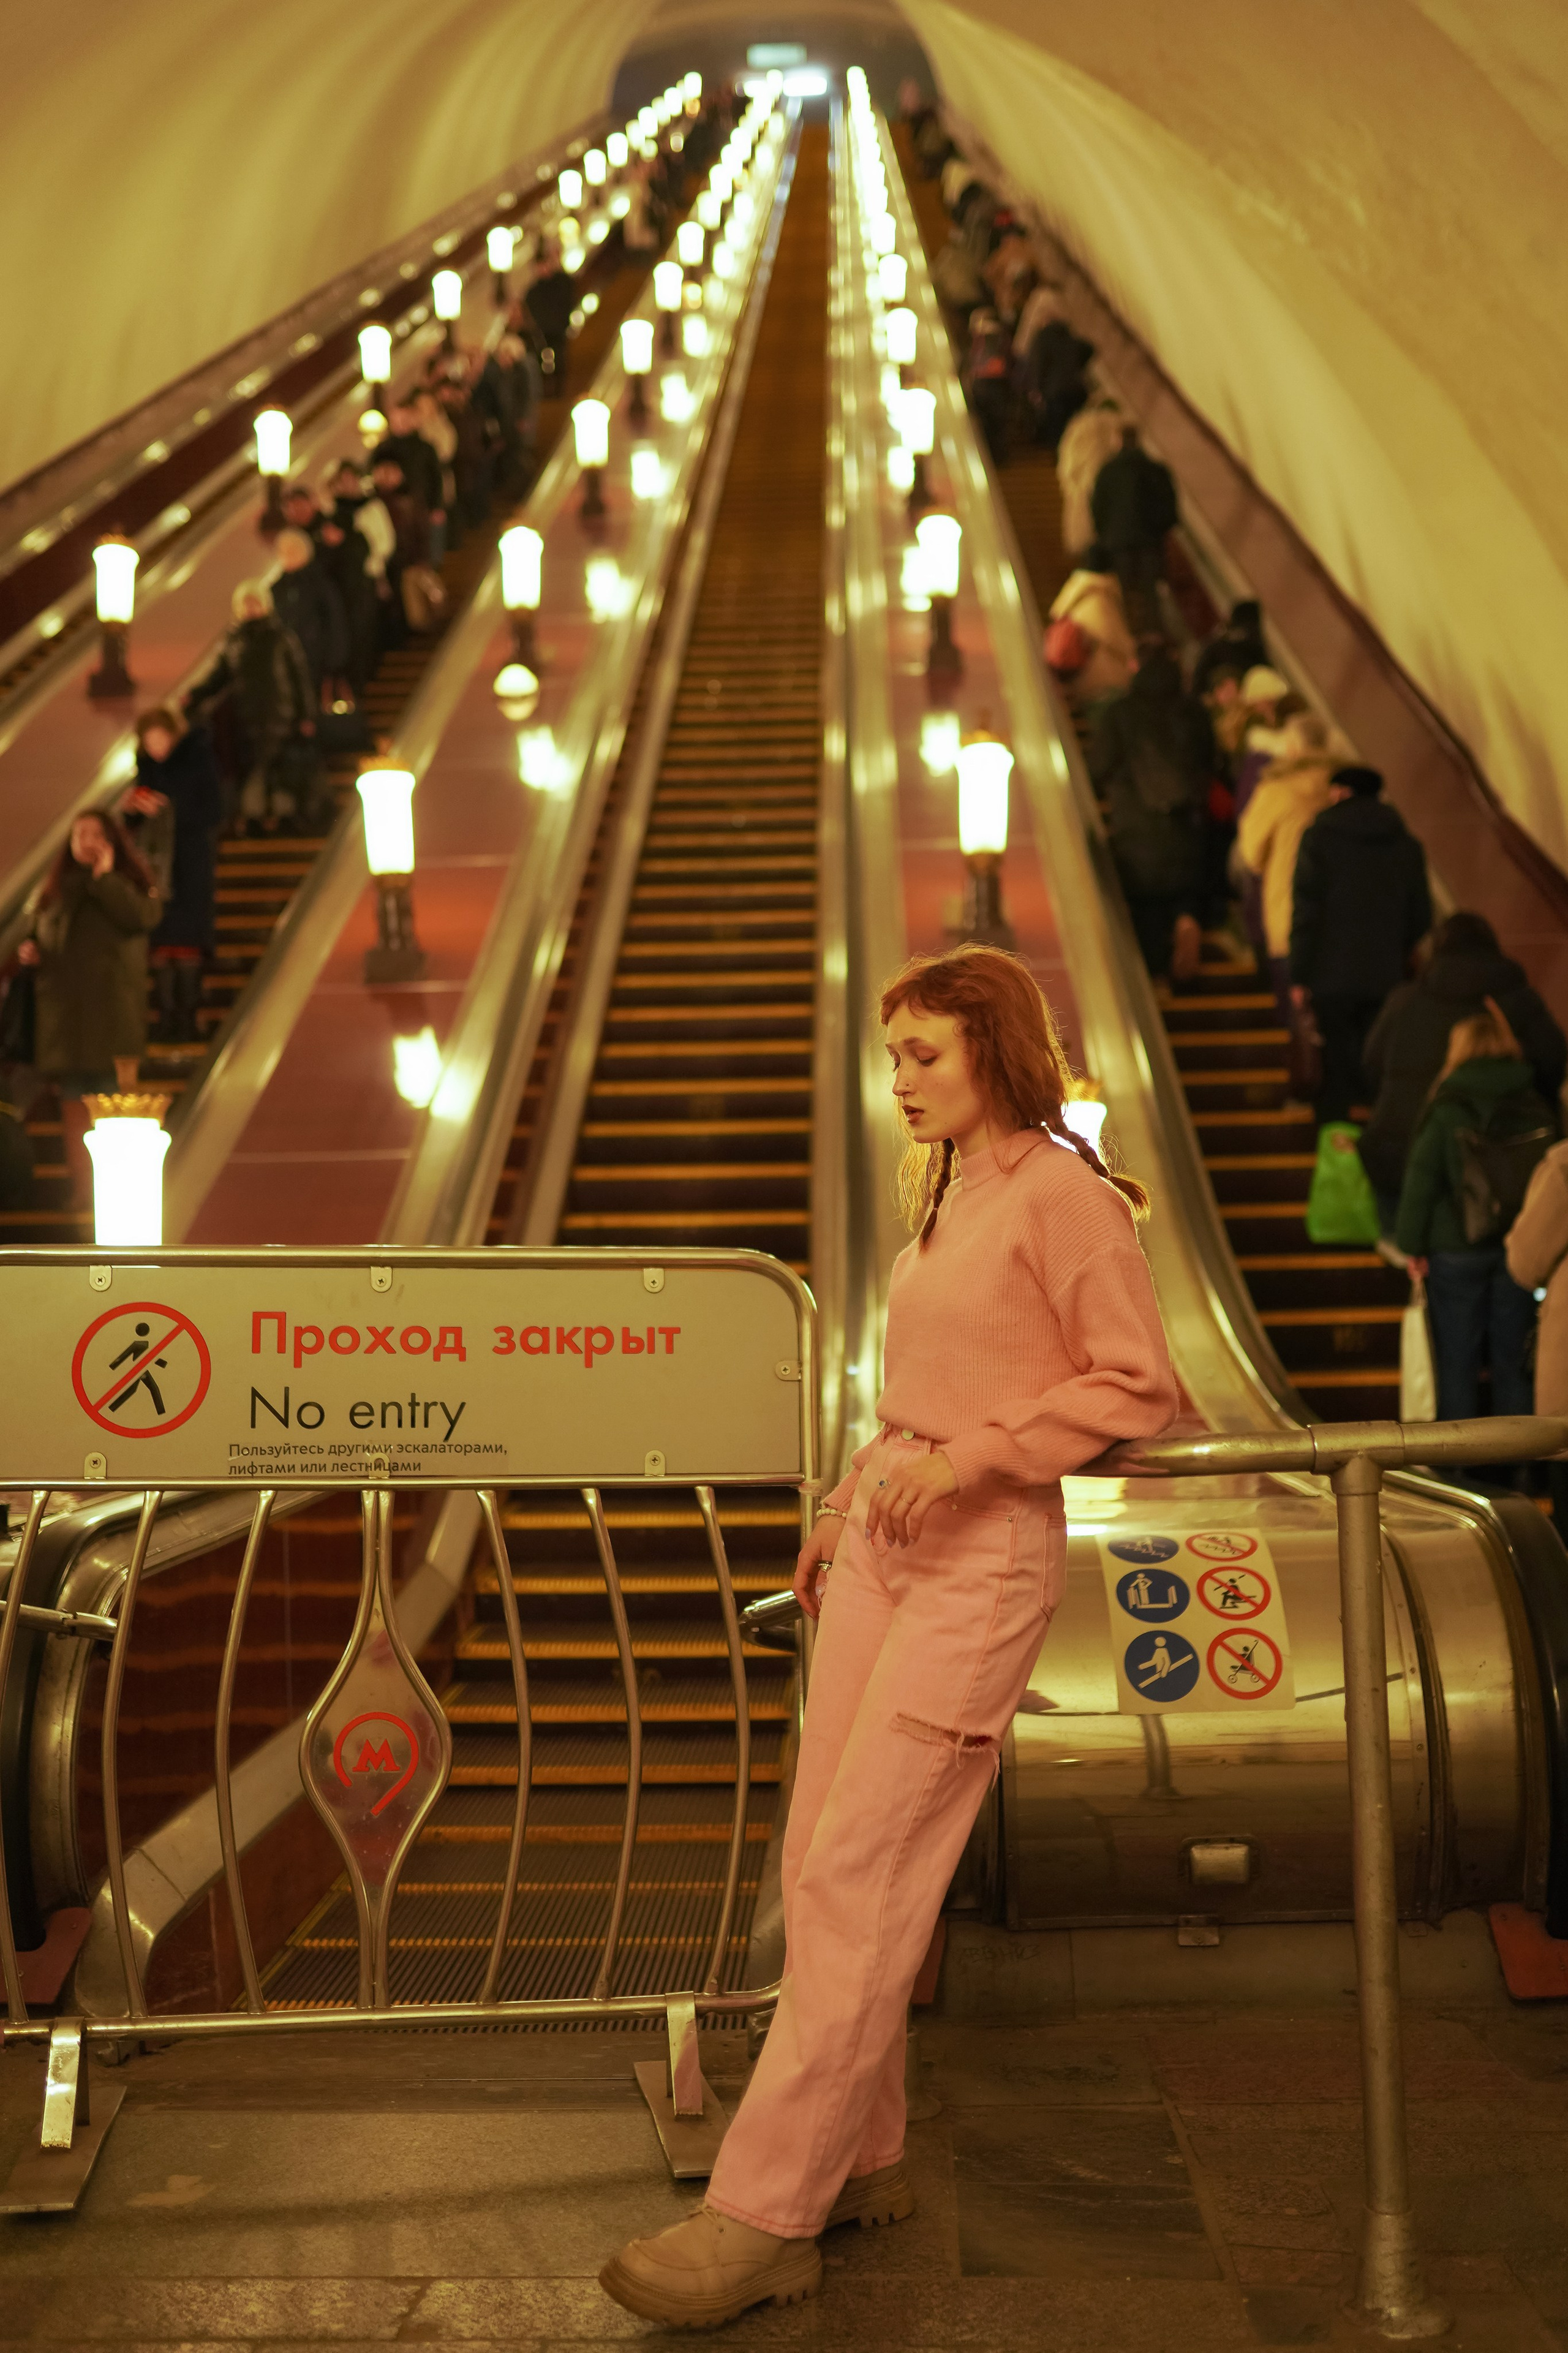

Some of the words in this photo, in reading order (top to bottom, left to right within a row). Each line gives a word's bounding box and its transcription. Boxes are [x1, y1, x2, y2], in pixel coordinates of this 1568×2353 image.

[252, 1312, 466, 1368] Проход
[492, 1326, 680, 1368] закрыт
[251, 1386, 325, 1429] No
[349, 1392, 466, 1441] entry
[229, 1443, 324, 1457] Пользуйтесь
[328, 1443, 392, 1457] другими
[397, 1443, 508, 1456] эскалаторами,
[228, 1461, 295, 1476] лифтами
[301, 1464, 326, 1473] или
[331, 1462, 421, 1473] лестницами
